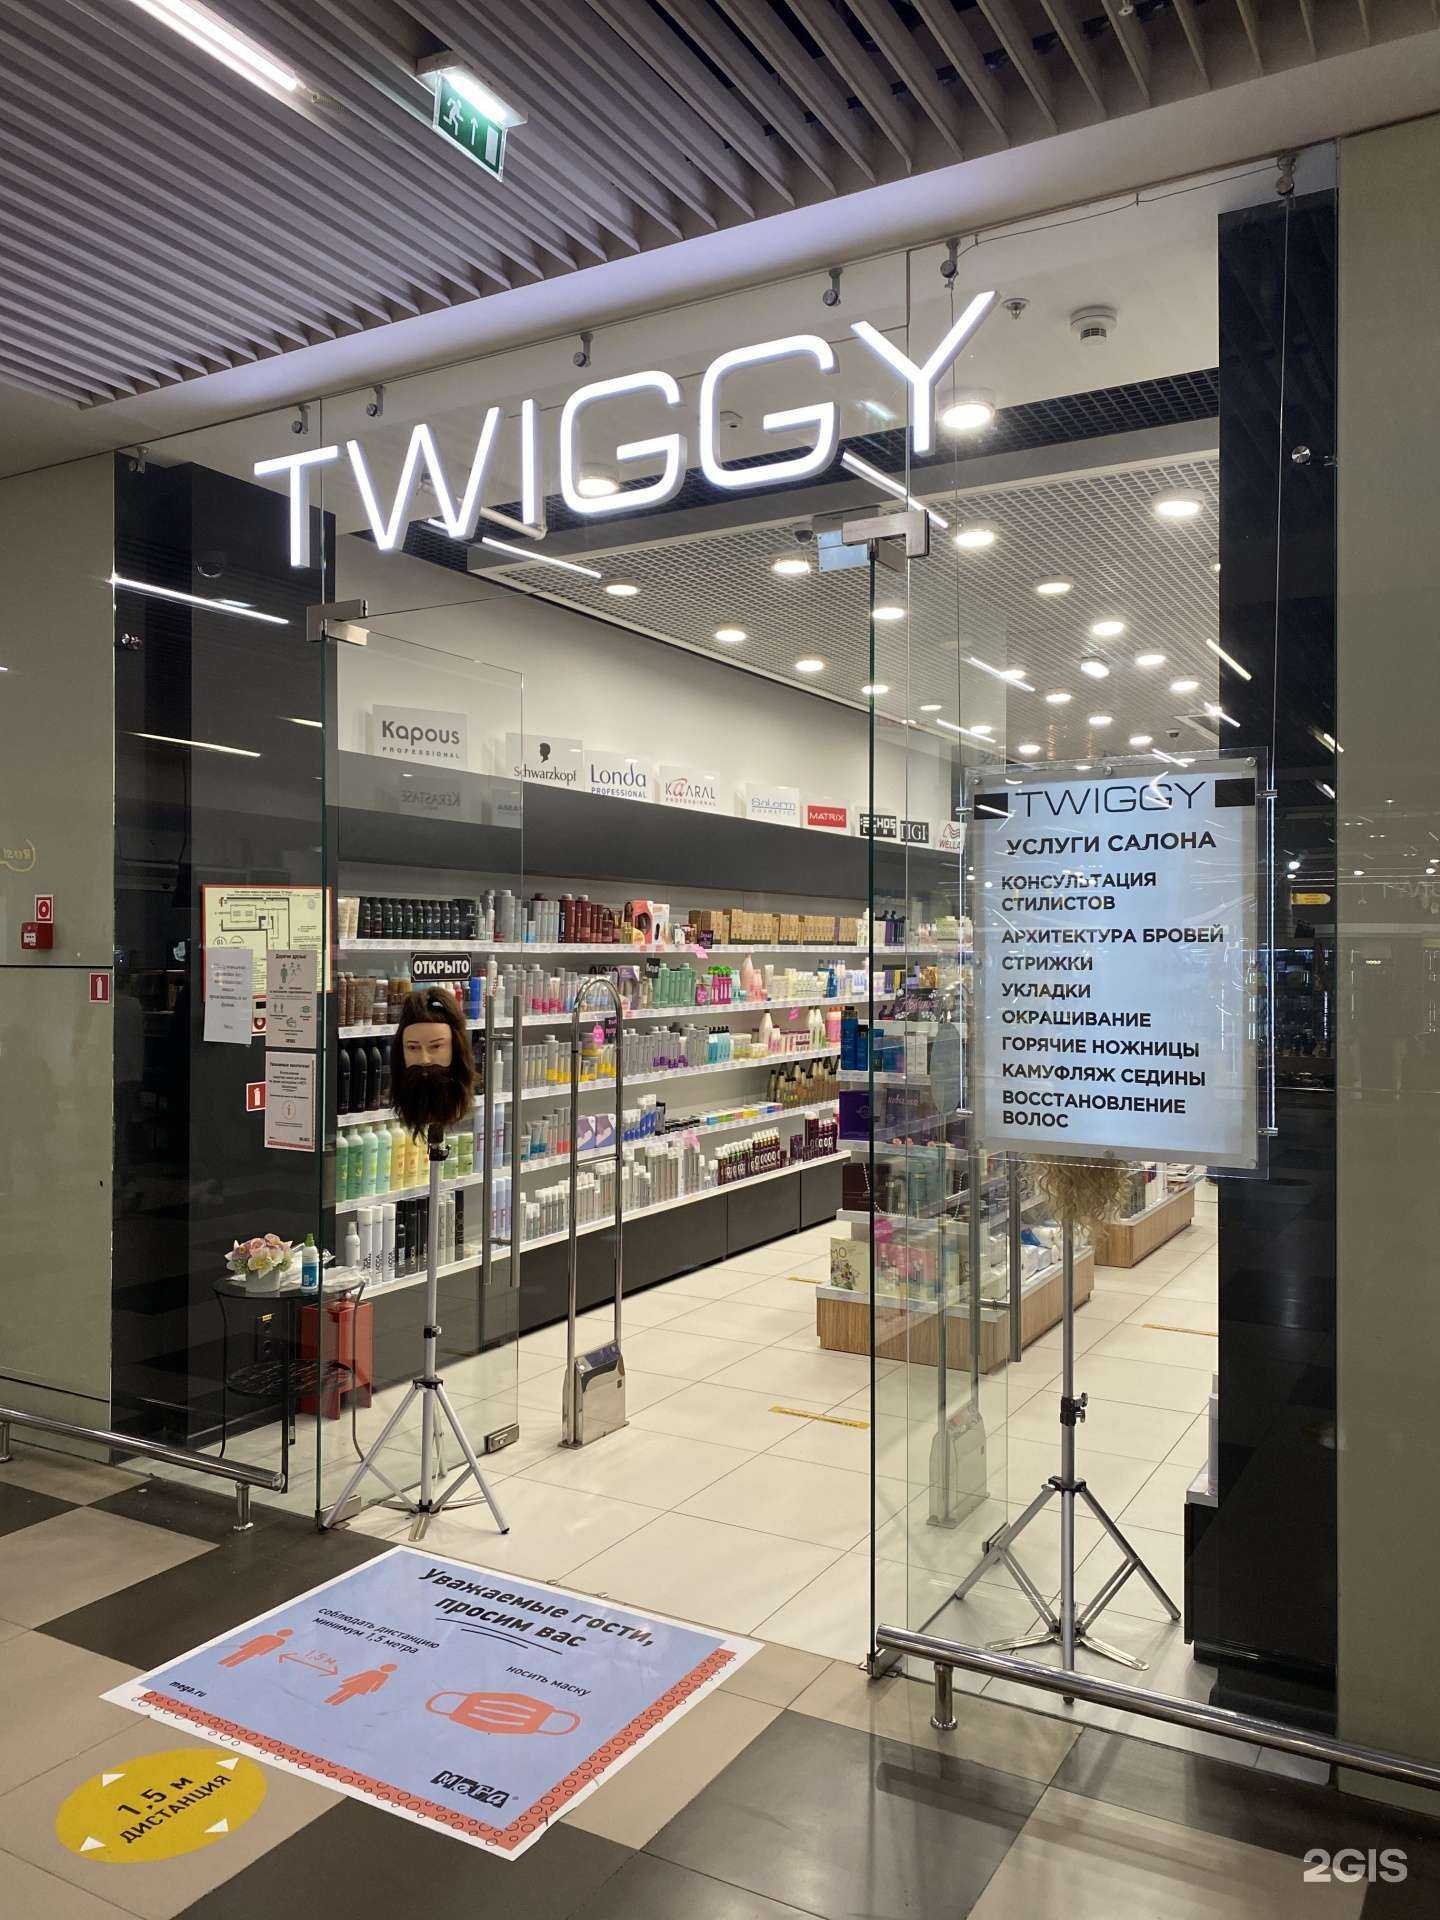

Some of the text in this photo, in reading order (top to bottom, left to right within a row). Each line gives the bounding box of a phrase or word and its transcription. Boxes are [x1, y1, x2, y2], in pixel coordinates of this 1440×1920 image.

[254, 291, 998, 567] TWIGGY
[382, 720, 460, 746] Kapous
[514, 764, 576, 785] Schwarzkopf
[591, 764, 646, 787] Londa
[591, 787, 646, 799] PROFESSIONAL
[1015, 781, 1205, 817] TWIGGY
[809, 812, 844, 822] MATRIX
[1007, 831, 1217, 855] УСЛУГИ САЛОНА
[1001, 872, 1157, 890] КОНСУЛЬТАЦИЯ
[1001, 896, 1116, 911] СТИЛИСТОВ
[1001, 924, 1224, 944] АРХИТЕКТУРА БРОВЕЙ
[413, 959, 469, 975] ОТКРЫТО
[1001, 956, 1093, 971] СТРИЖКИ
[1001, 983, 1091, 1000] УКЛАДКИ
[1001, 1010, 1151, 1028] ОКРАШИВАНИЕ
[1001, 1037, 1199, 1059] ГОРЯЧИЕ НОЖНИЦЫ
[1001, 1064, 1206, 1087] КАМУФЛЯЖ СЕДИНЫ
[1002, 1090, 1186, 1114] ВОССТАНОВЛЕНИЕ
[1002, 1112, 1069, 1129] ВОЛОС
[419, 1567, 654, 1647] Уважаемые гости,
[318, 1607, 440, 1650] соблюдать дистанцию
[435, 1597, 587, 1648] просим вас
[312, 1617, 420, 1655] минимум 1,5 метра
[169, 1680, 207, 1698] mega.ru
[506, 1666, 592, 1698] носить маску
[119, 1774, 232, 1844] ДИСТАНЦИЯ
